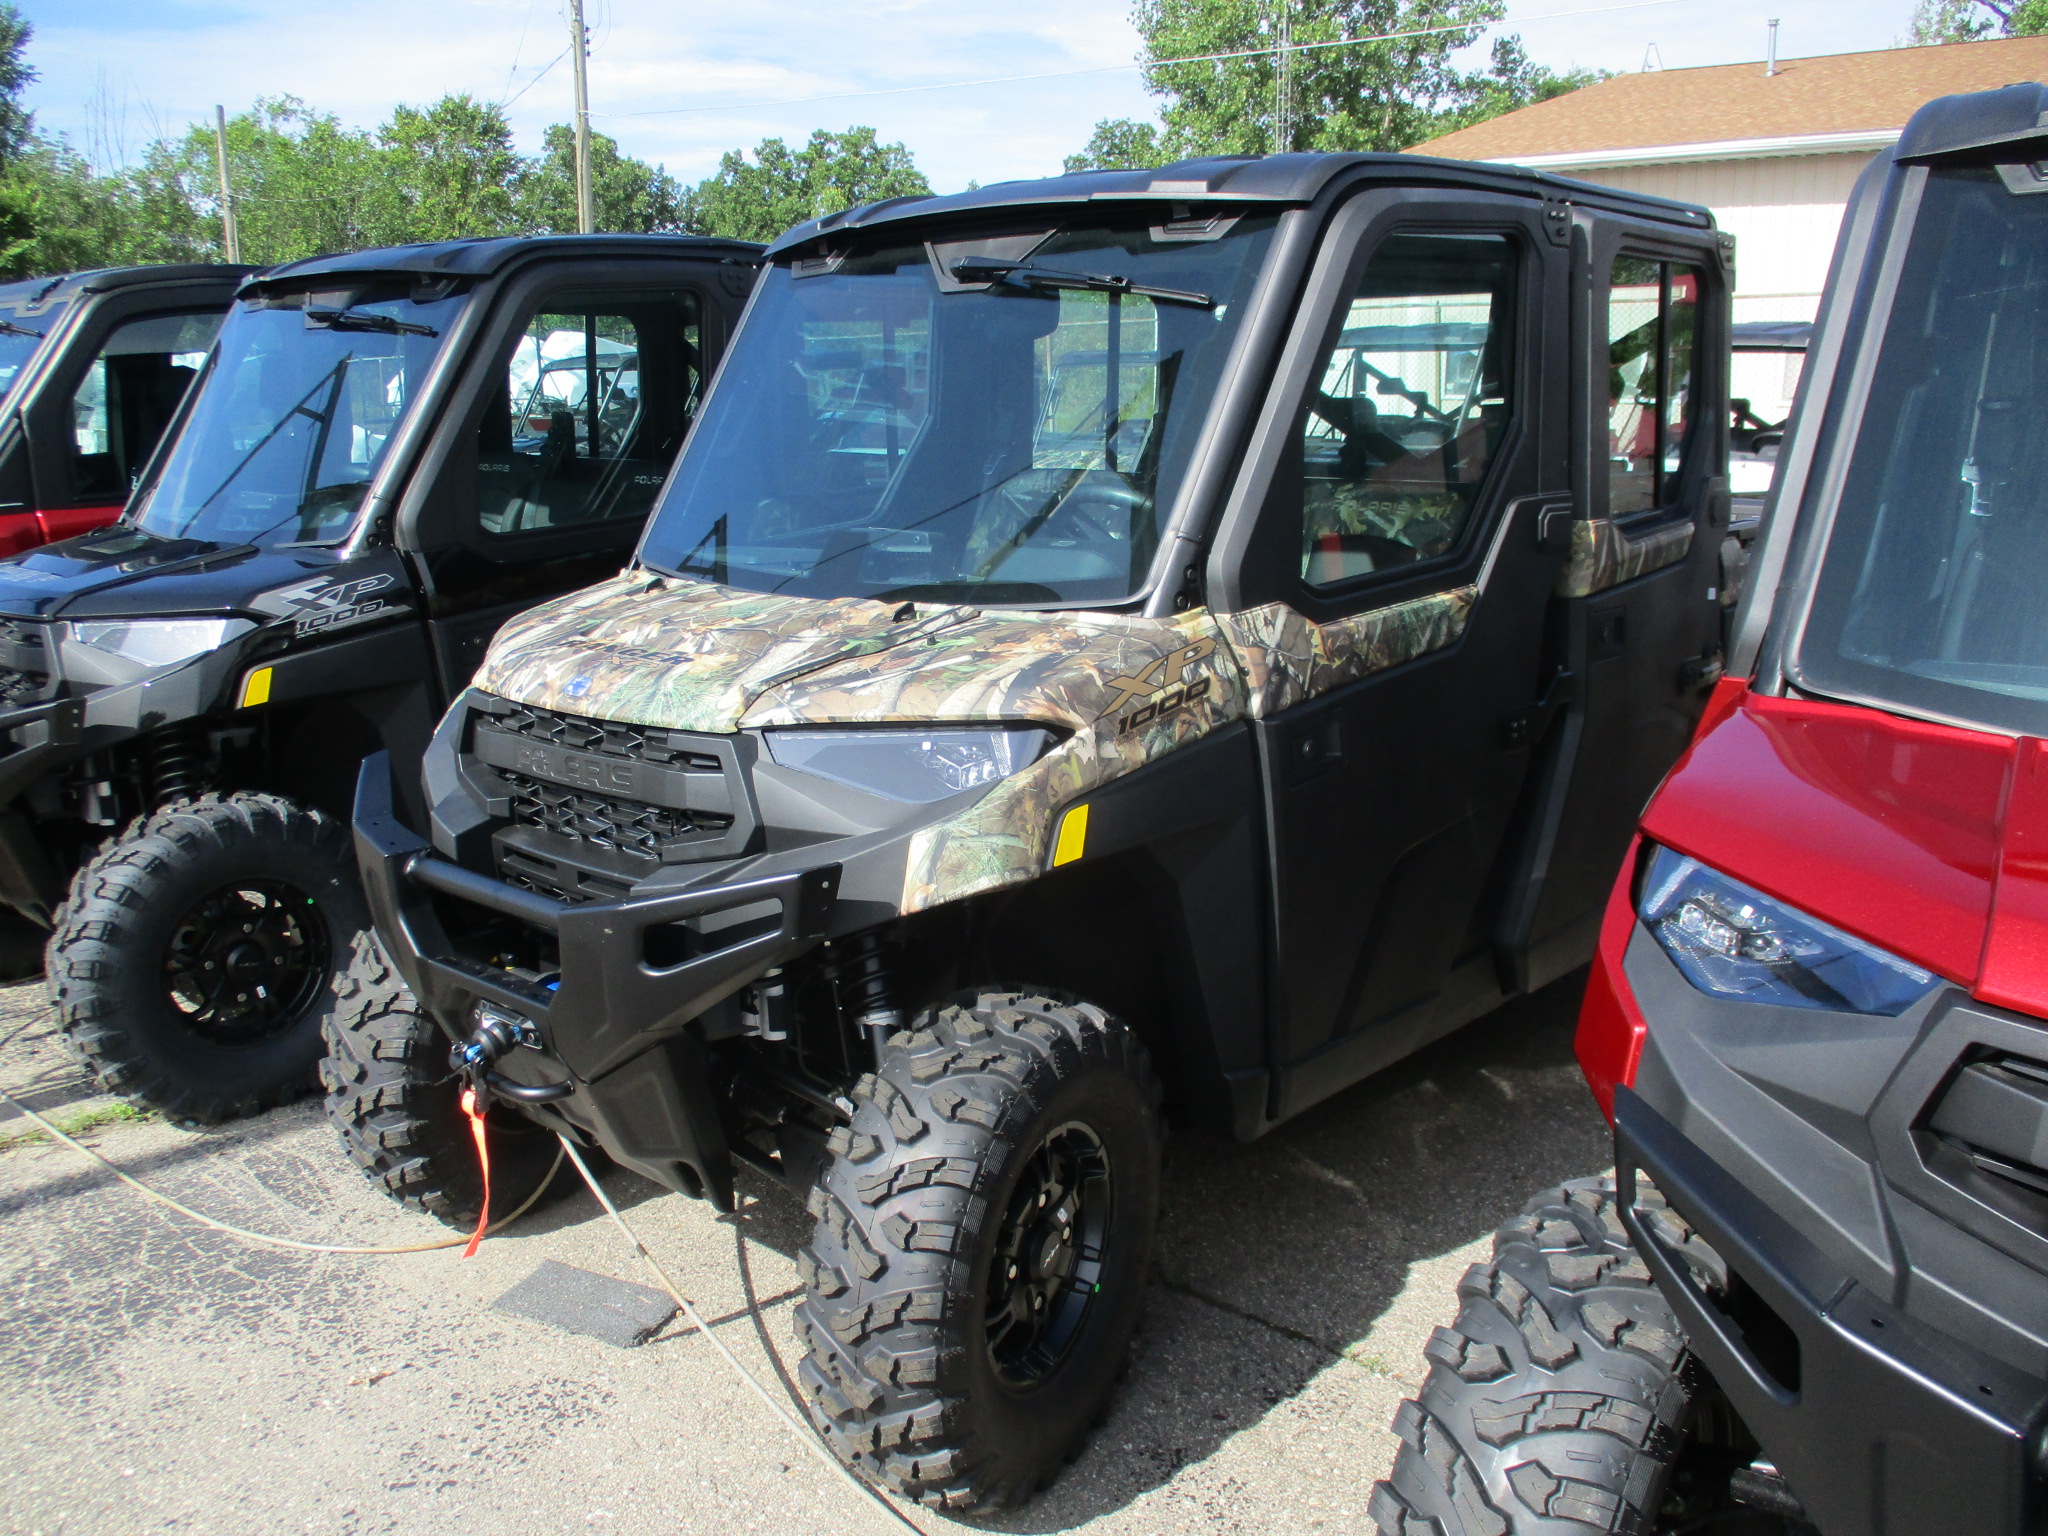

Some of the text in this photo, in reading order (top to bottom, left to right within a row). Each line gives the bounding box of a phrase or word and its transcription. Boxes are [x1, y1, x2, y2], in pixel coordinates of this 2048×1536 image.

[267, 573, 395, 627] XP
[296, 599, 384, 634] 1000
[1092, 636, 1218, 723] XP
[1118, 677, 1210, 735] 1000
[517, 747, 634, 794] POLARIS
